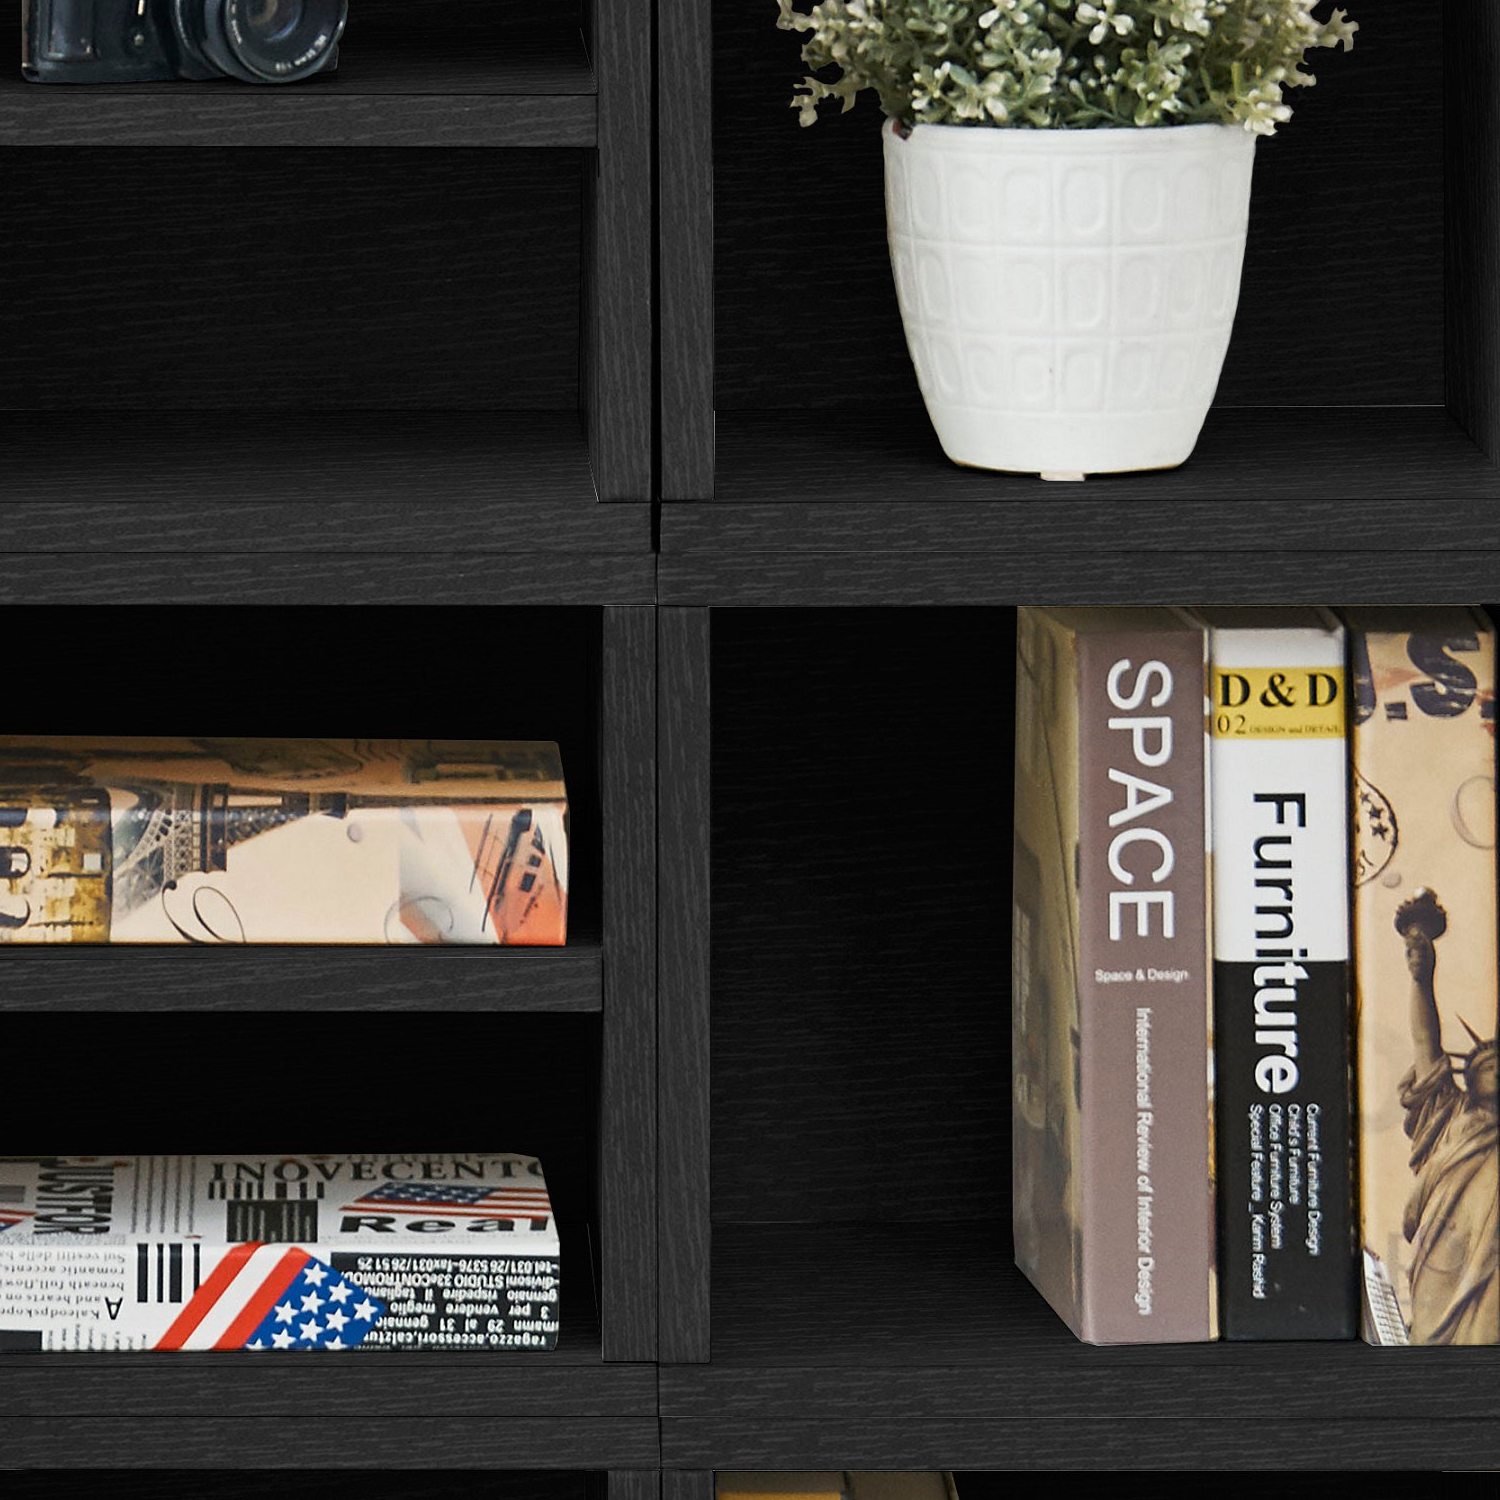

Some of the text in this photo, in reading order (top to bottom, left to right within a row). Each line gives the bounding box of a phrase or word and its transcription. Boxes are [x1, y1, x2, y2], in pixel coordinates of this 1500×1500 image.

[1219, 672, 1338, 707] D & D
[1106, 658, 1175, 941] SPACE
[1253, 793, 1309, 1093] Furniture
[1094, 968, 1133, 984] Space
[1146, 966, 1189, 984] Design
[1248, 1103, 1264, 1151] Special
[1134, 1007, 1156, 1315] International Review of Interior Design
[1250, 1152, 1266, 1202] Feature
[1267, 1103, 1286, 1250] Office Furniture System
[1287, 1147, 1303, 1204] Furniture
[1305, 1103, 1323, 1256] Current Furniture Design
[339, 1215, 549, 1233] Real
[59, 1265, 126, 1277] romantic
[68, 1280, 126, 1292] beneath
[453, 1273, 505, 1290] STUDIO
[442, 1286, 499, 1304] rispedire
[506, 1288, 558, 1304] gennaio
[389, 1298, 436, 1317] meglio
[445, 1302, 500, 1318] vendere
[507, 1302, 532, 1317] per
[439, 1317, 456, 1332] 31
[464, 1318, 479, 1332] al
[486, 1318, 506, 1333] 29
